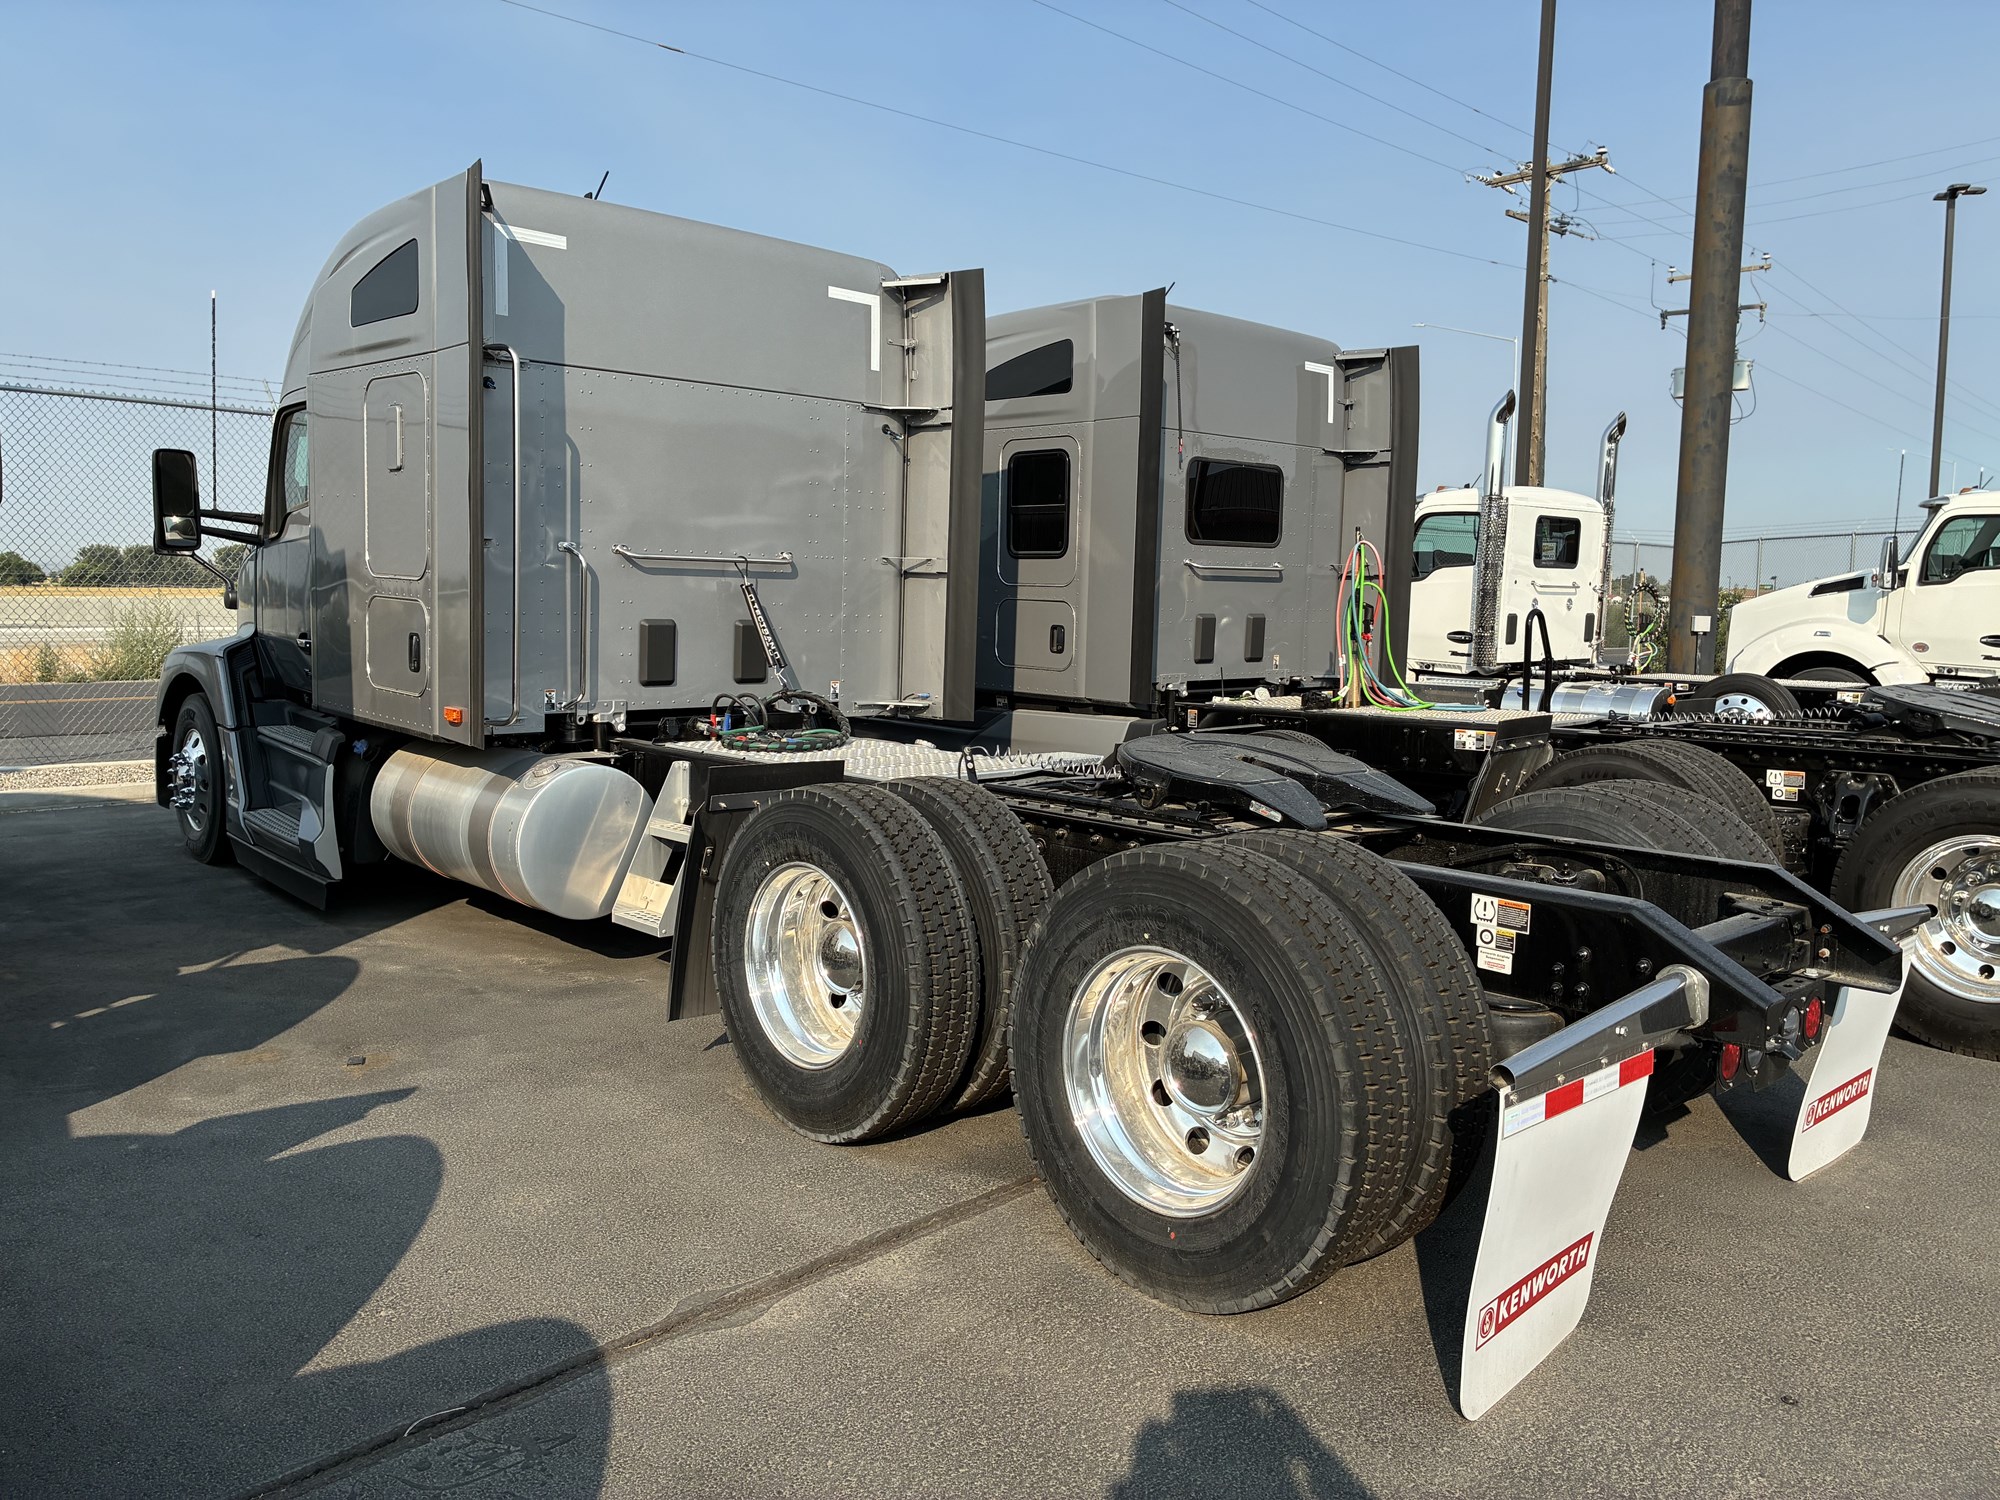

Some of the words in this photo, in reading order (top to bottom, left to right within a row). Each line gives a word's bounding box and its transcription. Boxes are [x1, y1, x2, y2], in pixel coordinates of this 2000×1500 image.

[752, 601, 778, 651] TECTRAN
[1815, 1074, 1870, 1119] KENWORTH
[1498, 1240, 1589, 1324] KENWORTH
